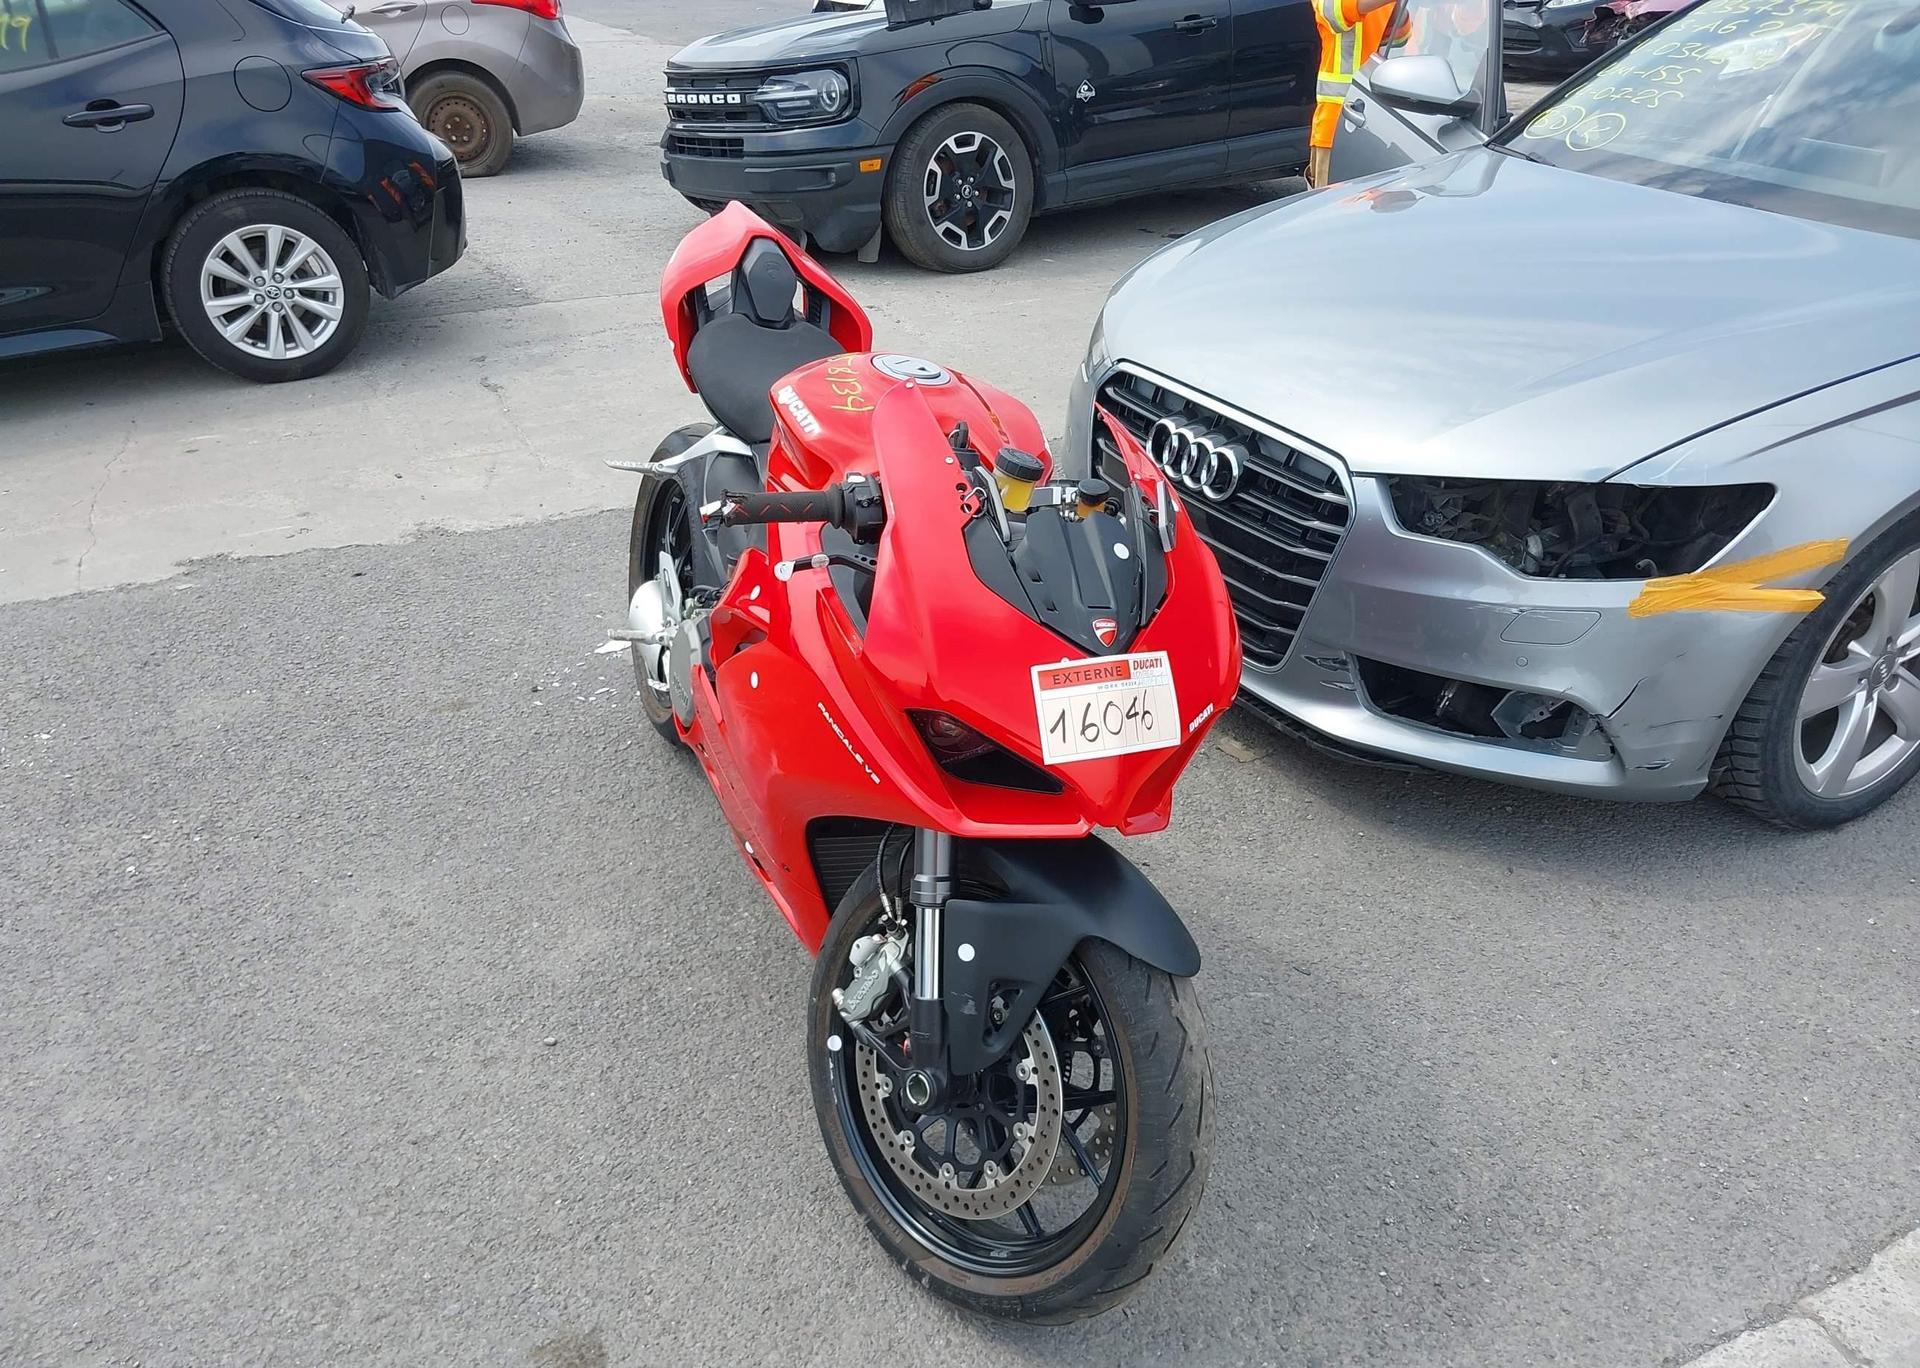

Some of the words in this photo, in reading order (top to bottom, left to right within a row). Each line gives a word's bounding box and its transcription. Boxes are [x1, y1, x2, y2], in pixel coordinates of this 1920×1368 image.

[666, 93, 742, 105] BRONCO
[777, 385, 823, 436] DUCATI
[1052, 664, 1124, 686] EXTERNE
[1132, 658, 1163, 671] DUCATI
[817, 701, 864, 766] PANIGALE
[1049, 689, 1155, 744] 16046
[1188, 702, 1214, 734] DUCATI
